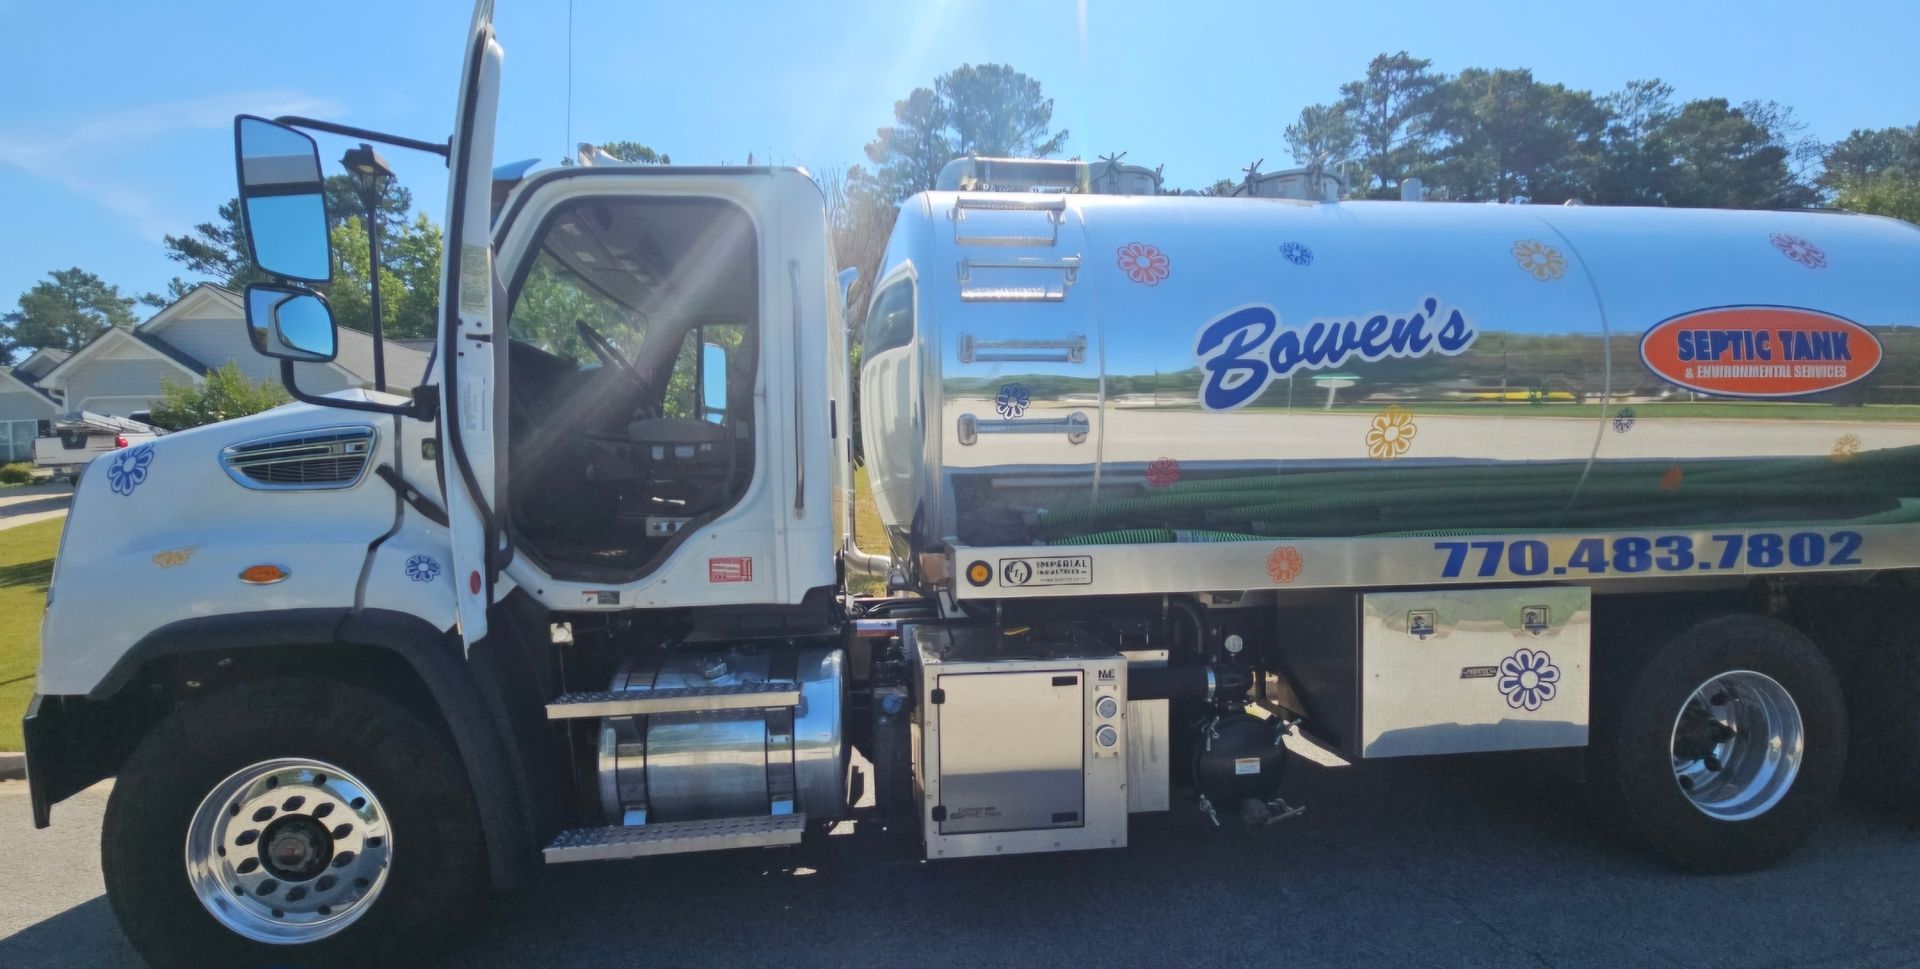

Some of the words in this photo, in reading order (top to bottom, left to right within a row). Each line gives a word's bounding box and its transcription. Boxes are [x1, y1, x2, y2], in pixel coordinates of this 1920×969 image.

[1196, 297, 1475, 411] Bowen's
[1677, 330, 1771, 362] SEPTIC
[1777, 330, 1853, 362] TANK
[1685, 367, 1694, 379] &
[1697, 365, 1793, 378] ENVIRONMENTAL
[1794, 365, 1847, 378] SERVICES
[1036, 559, 1088, 569] IMPERIAL
[1434, 531, 1863, 577] 770.483.7802
